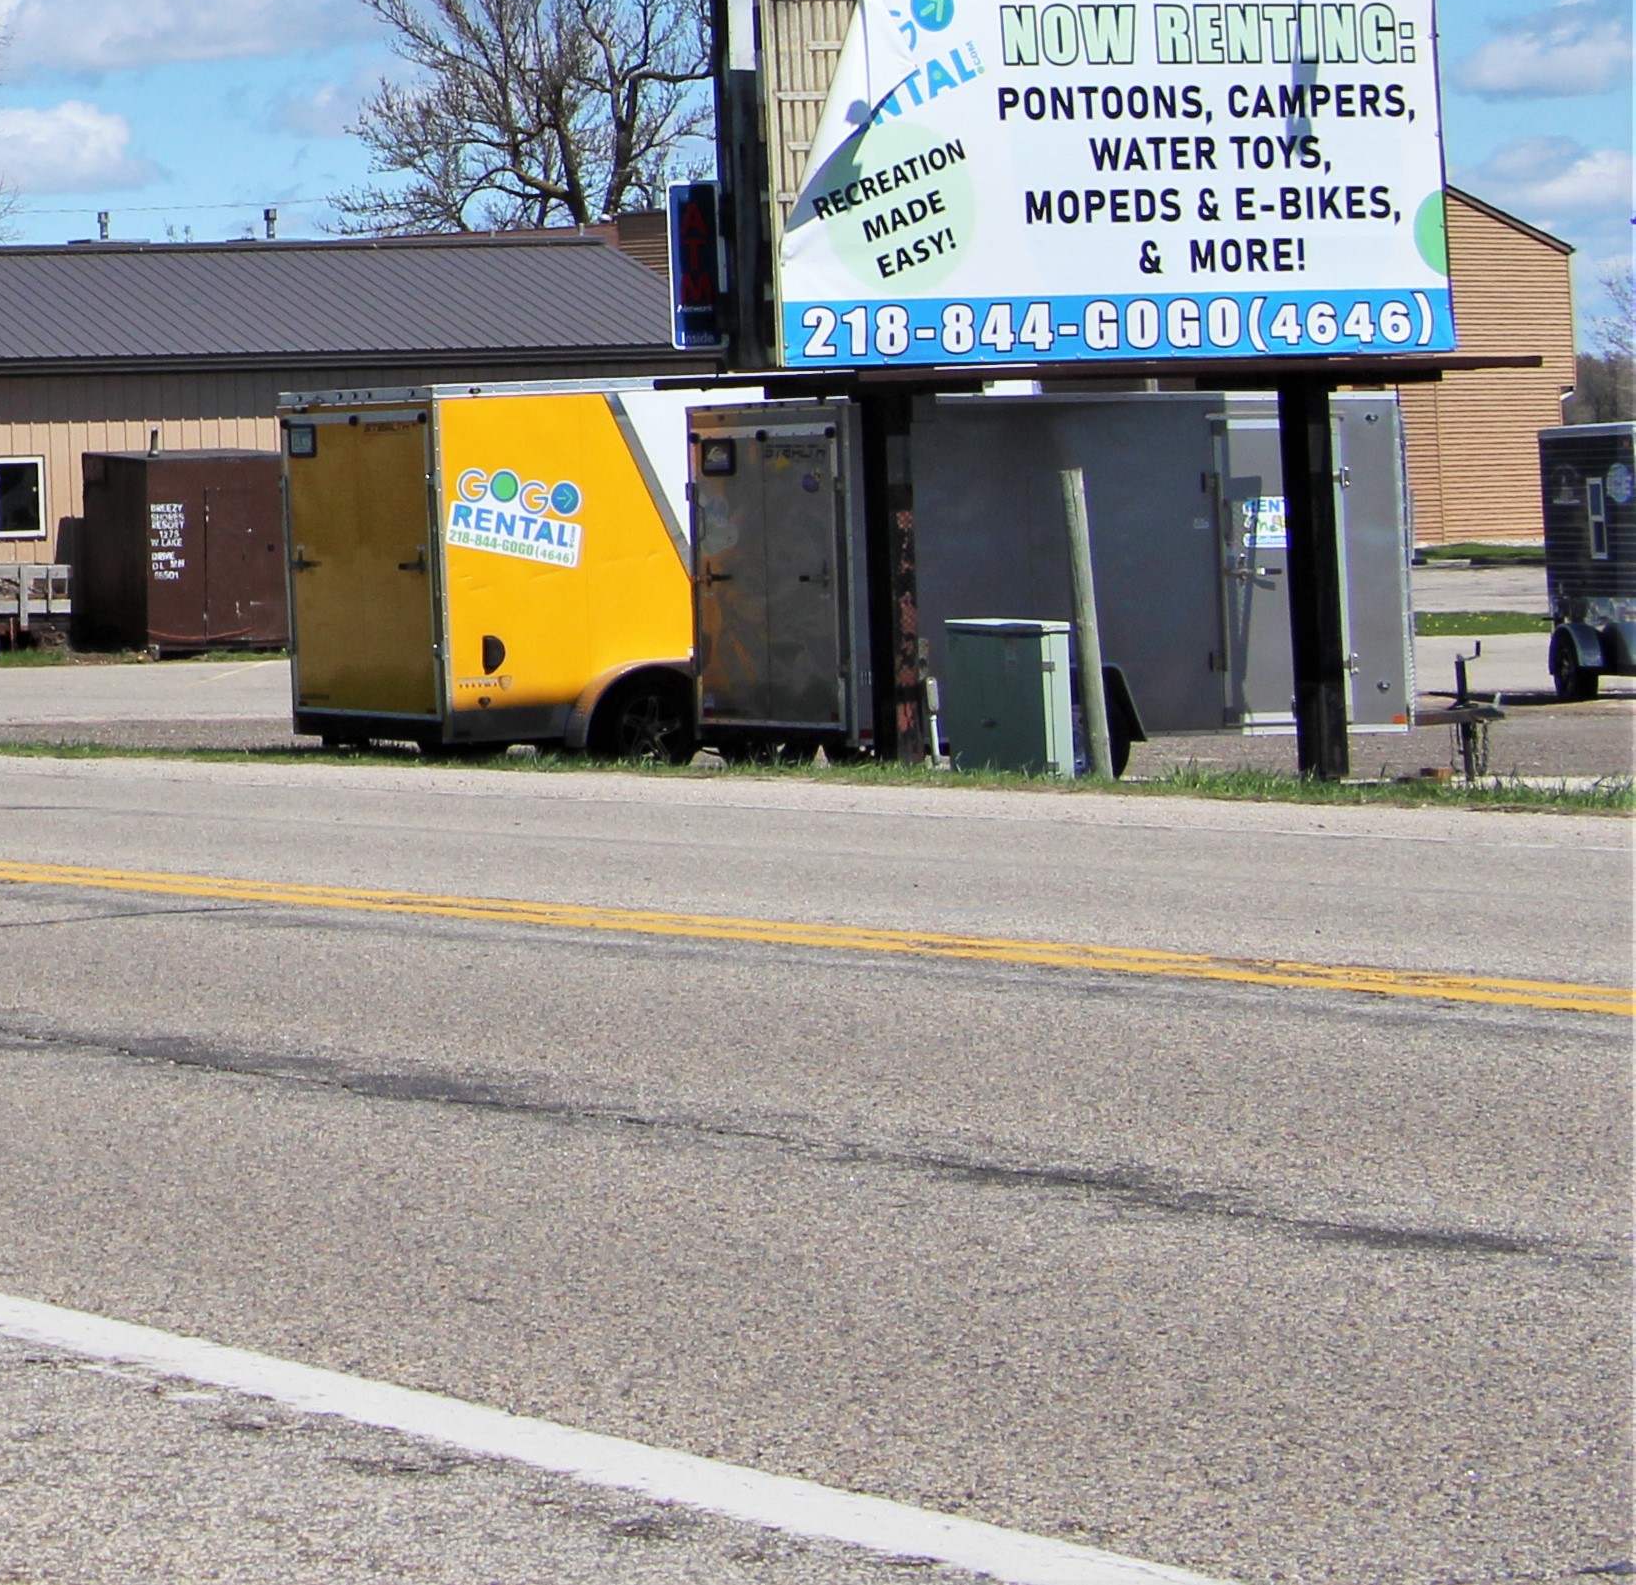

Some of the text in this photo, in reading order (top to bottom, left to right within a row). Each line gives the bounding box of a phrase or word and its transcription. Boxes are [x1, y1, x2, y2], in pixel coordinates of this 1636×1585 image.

[999, 2, 1137, 67] NOW
[1153, 1, 1417, 66] RENTING:
[997, 84, 1417, 126] PONTOONS, CAMPERS,
[1088, 135, 1332, 176] WATER TOYS,
[811, 138, 967, 220] RECREATION
[861, 189, 948, 244] MADE
[1024, 185, 1402, 225] MOPEDS & E-BIKES,
[680, 201, 715, 303] ATM
[875, 226, 958, 279] EASY!
[1138, 237, 1307, 275] & MORE!
[681, 331, 715, 345] Inside
[801, 291, 1435, 358] 218-844-GOGO(4646)
[161, 538, 182, 547] LAKE
[451, 503, 569, 549] RENTAL
